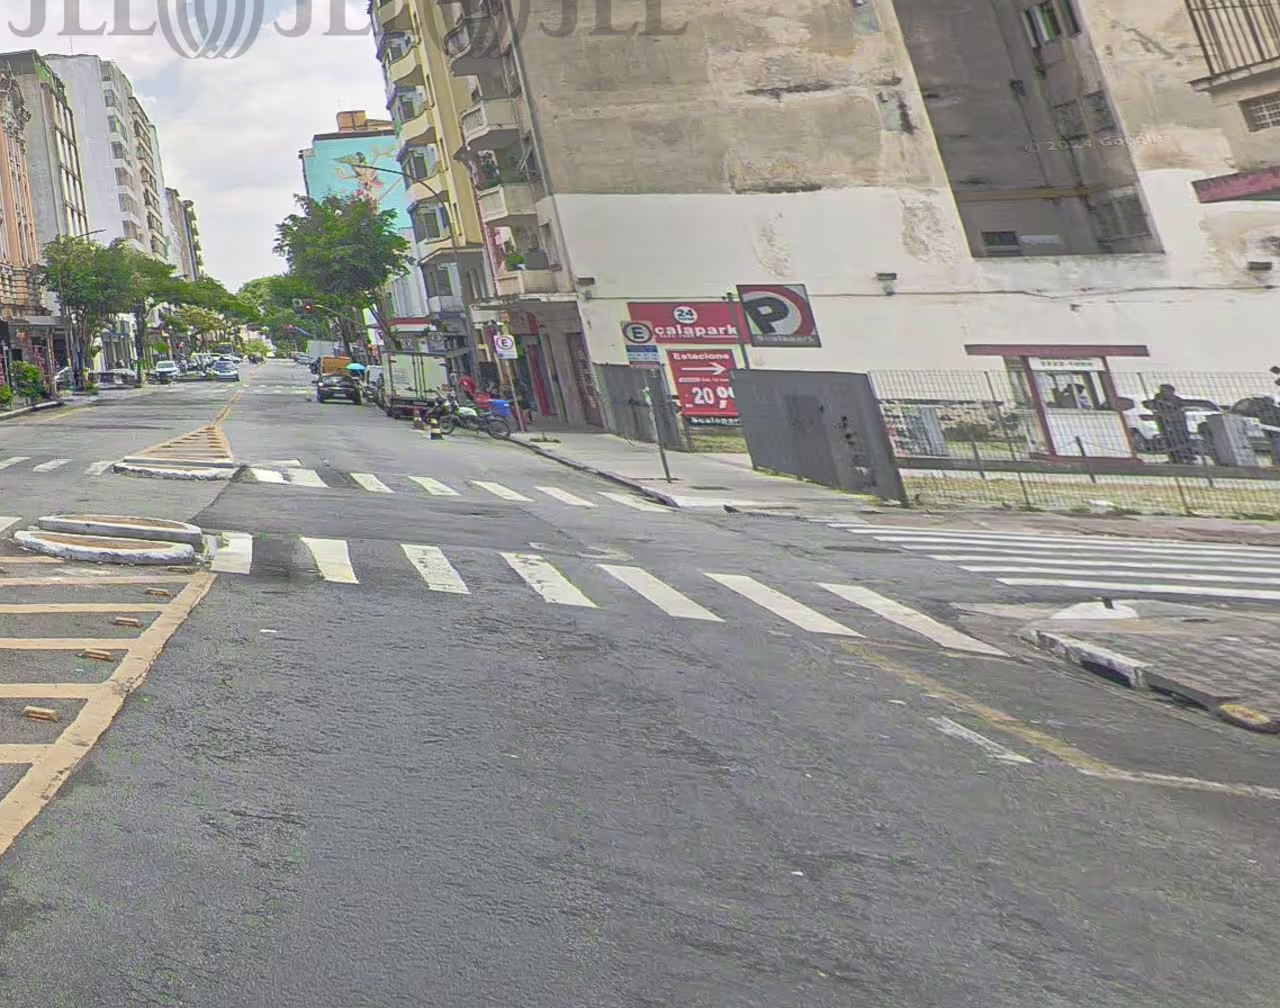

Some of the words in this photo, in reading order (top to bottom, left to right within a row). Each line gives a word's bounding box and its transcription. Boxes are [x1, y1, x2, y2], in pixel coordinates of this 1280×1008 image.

[676, 309, 694, 317] 24
[743, 296, 790, 335] P
[631, 326, 646, 339] E
[654, 324, 738, 337] calapark
[692, 386, 715, 405] 20
